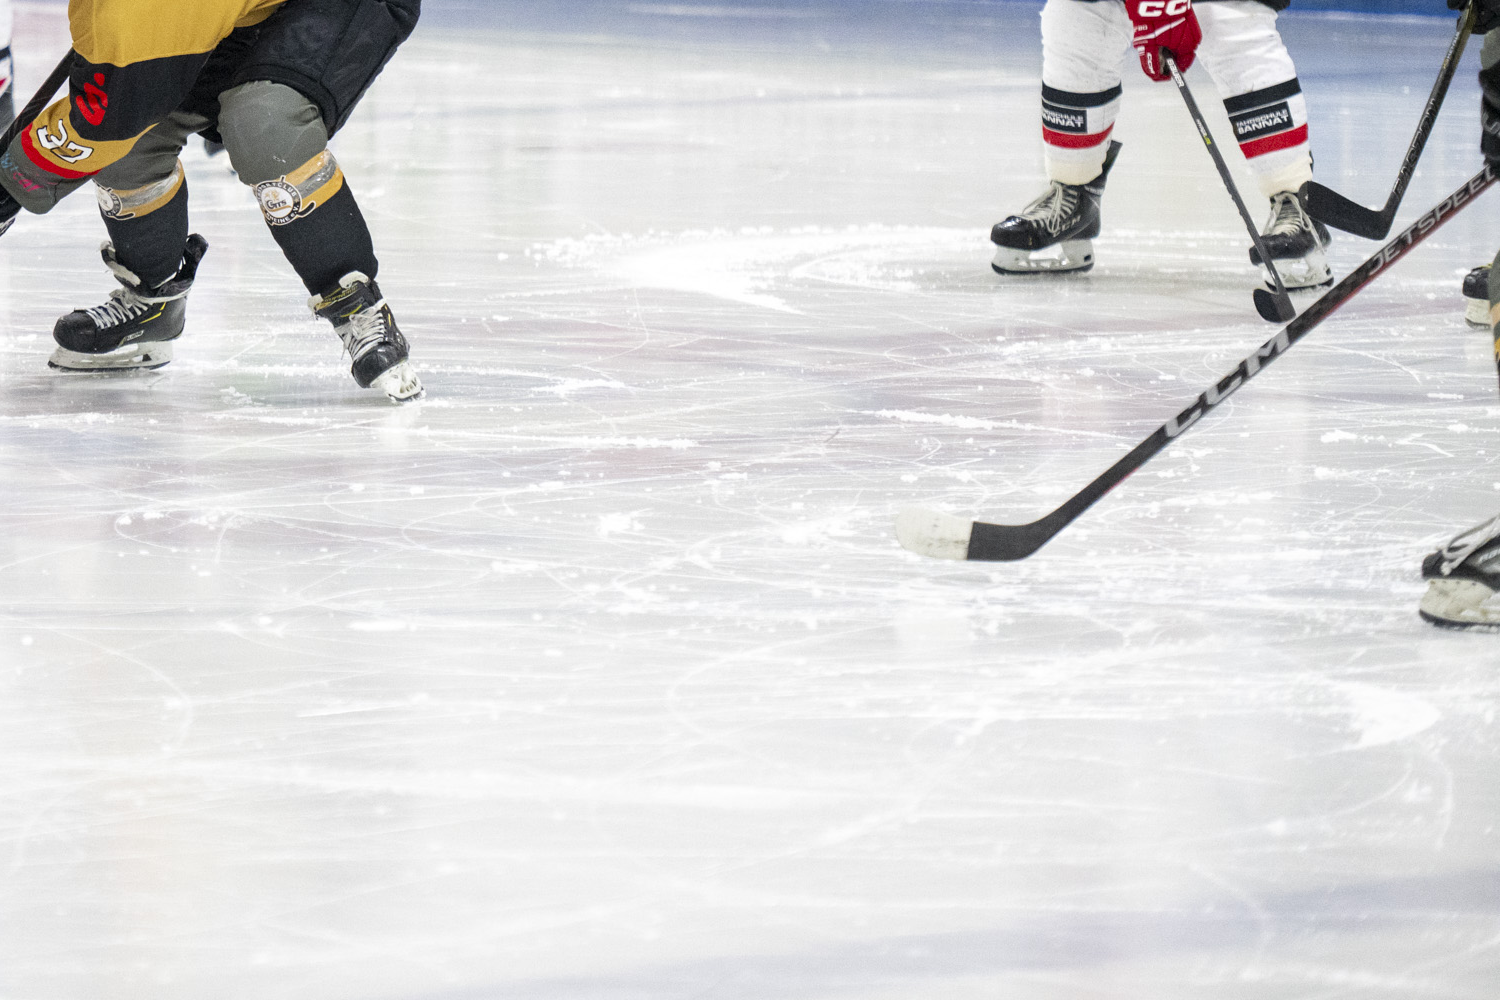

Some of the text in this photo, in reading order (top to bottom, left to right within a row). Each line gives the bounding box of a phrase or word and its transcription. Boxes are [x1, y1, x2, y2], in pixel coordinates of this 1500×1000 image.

[1166, 57, 1185, 88] BAUER
[1042, 112, 1084, 128] ANNAT
[1236, 115, 1289, 134] BANNAT
[1165, 328, 1290, 438] CCM
